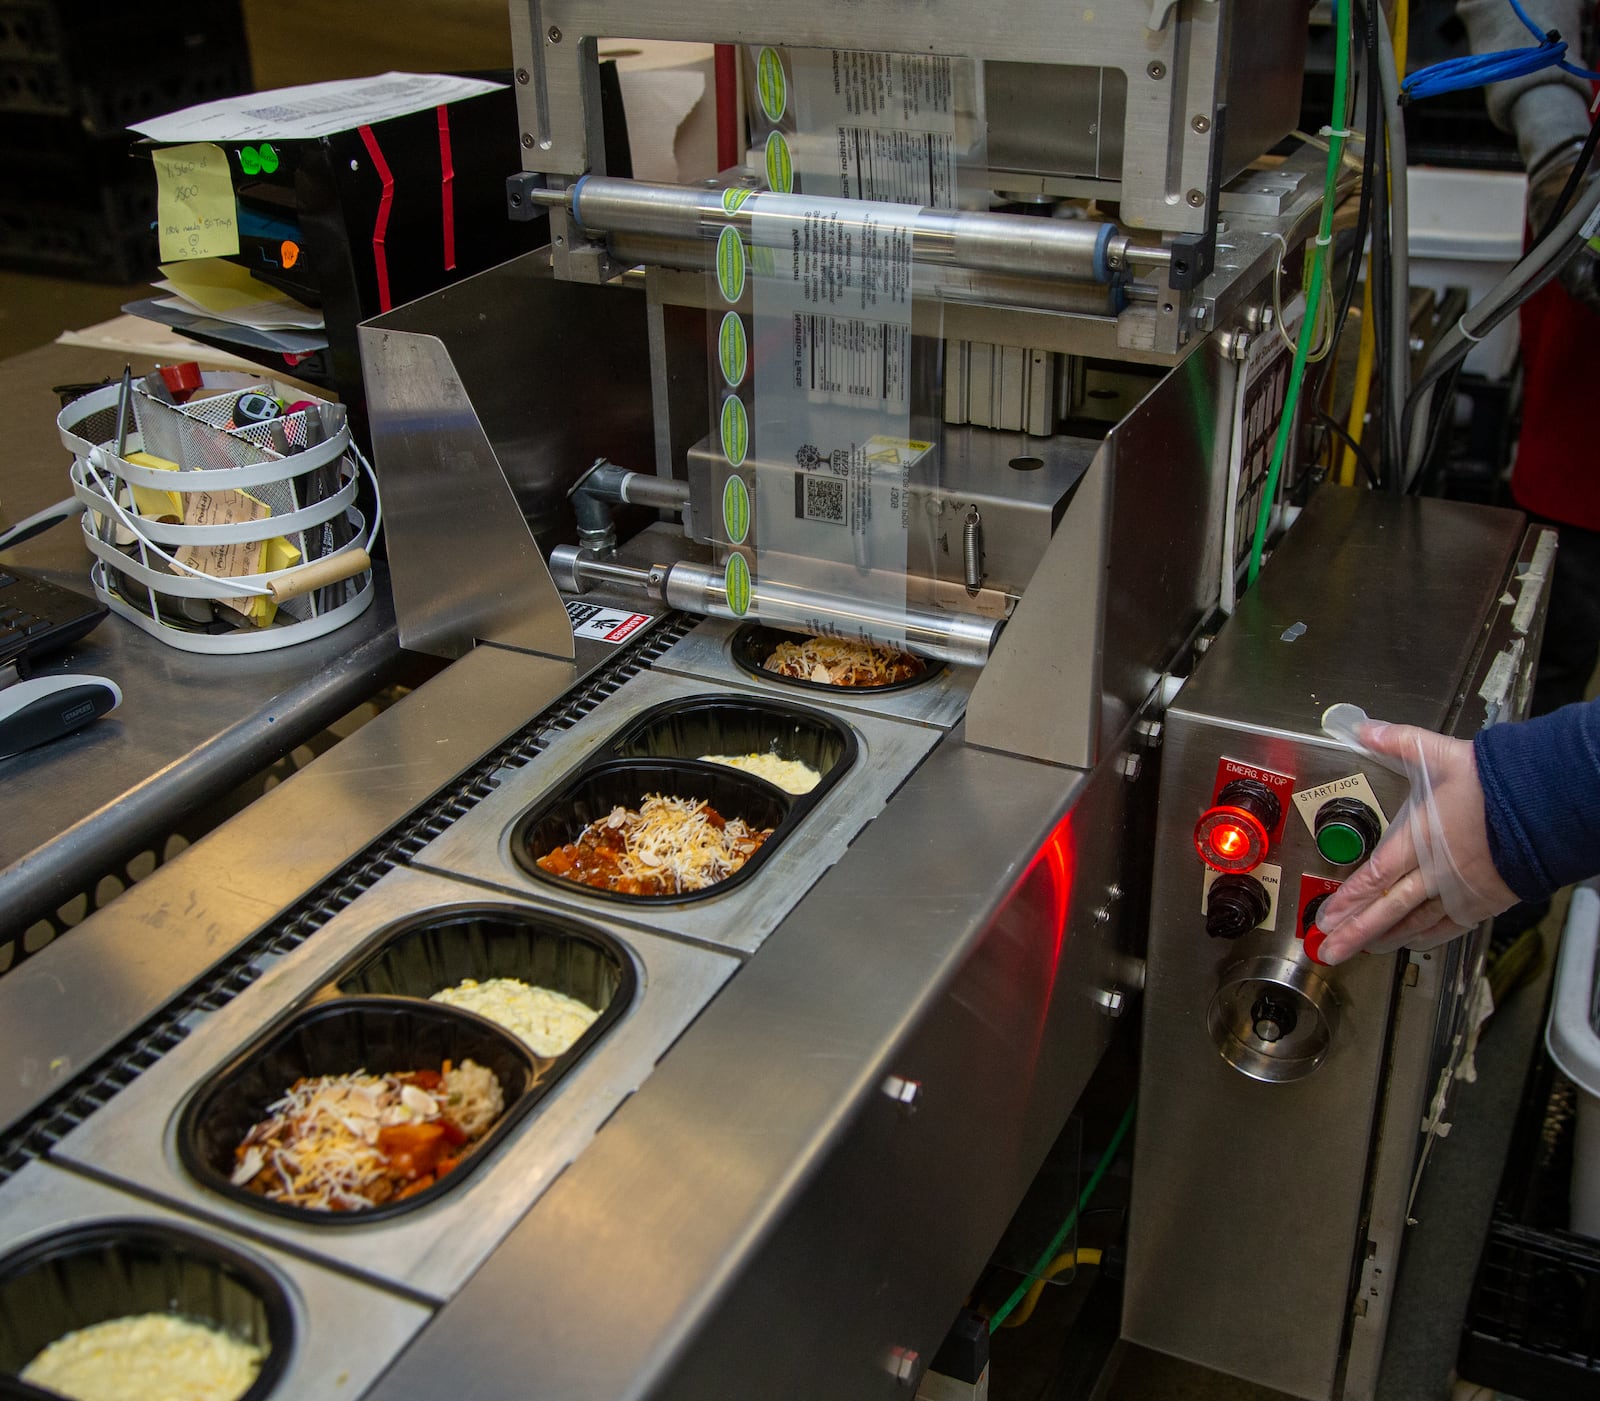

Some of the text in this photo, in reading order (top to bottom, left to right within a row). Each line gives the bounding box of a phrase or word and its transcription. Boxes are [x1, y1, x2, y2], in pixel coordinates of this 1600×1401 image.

[608, 618, 641, 640] DANGER
[1226, 763, 1288, 788] EMERG. STOP
[1300, 779, 1359, 802] START/JOG
[1262, 875, 1278, 886] RUN
